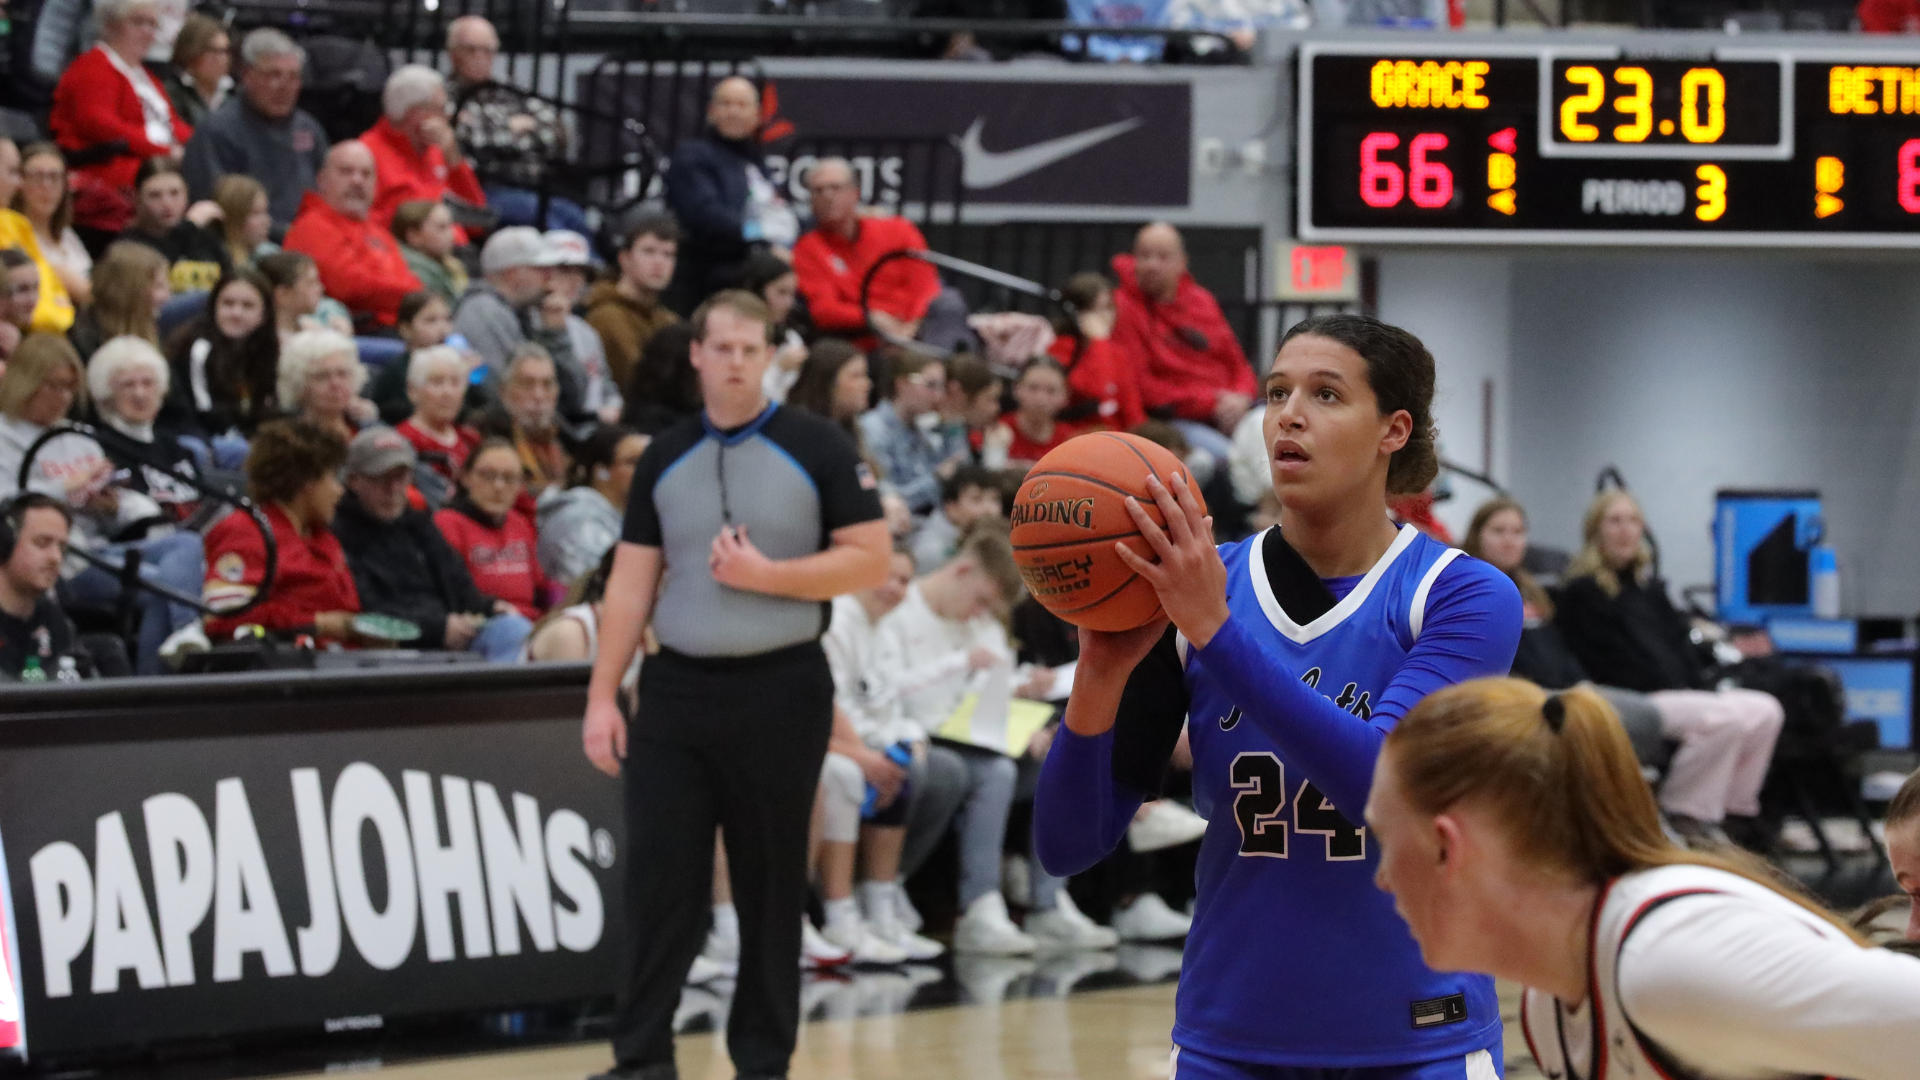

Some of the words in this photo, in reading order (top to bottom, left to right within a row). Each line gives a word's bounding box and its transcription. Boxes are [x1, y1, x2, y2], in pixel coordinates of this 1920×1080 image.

[1371, 60, 1490, 109] GRACE
[1560, 66, 1726, 143] 23.0
[1360, 132, 1454, 208] 66
[1582, 178, 1685, 216] PERIOD
[1695, 164, 1727, 221] 3
[1230, 751, 1366, 861] 24
[30, 777, 297, 998] PAPA
[1452, 1003, 1459, 1014] L
